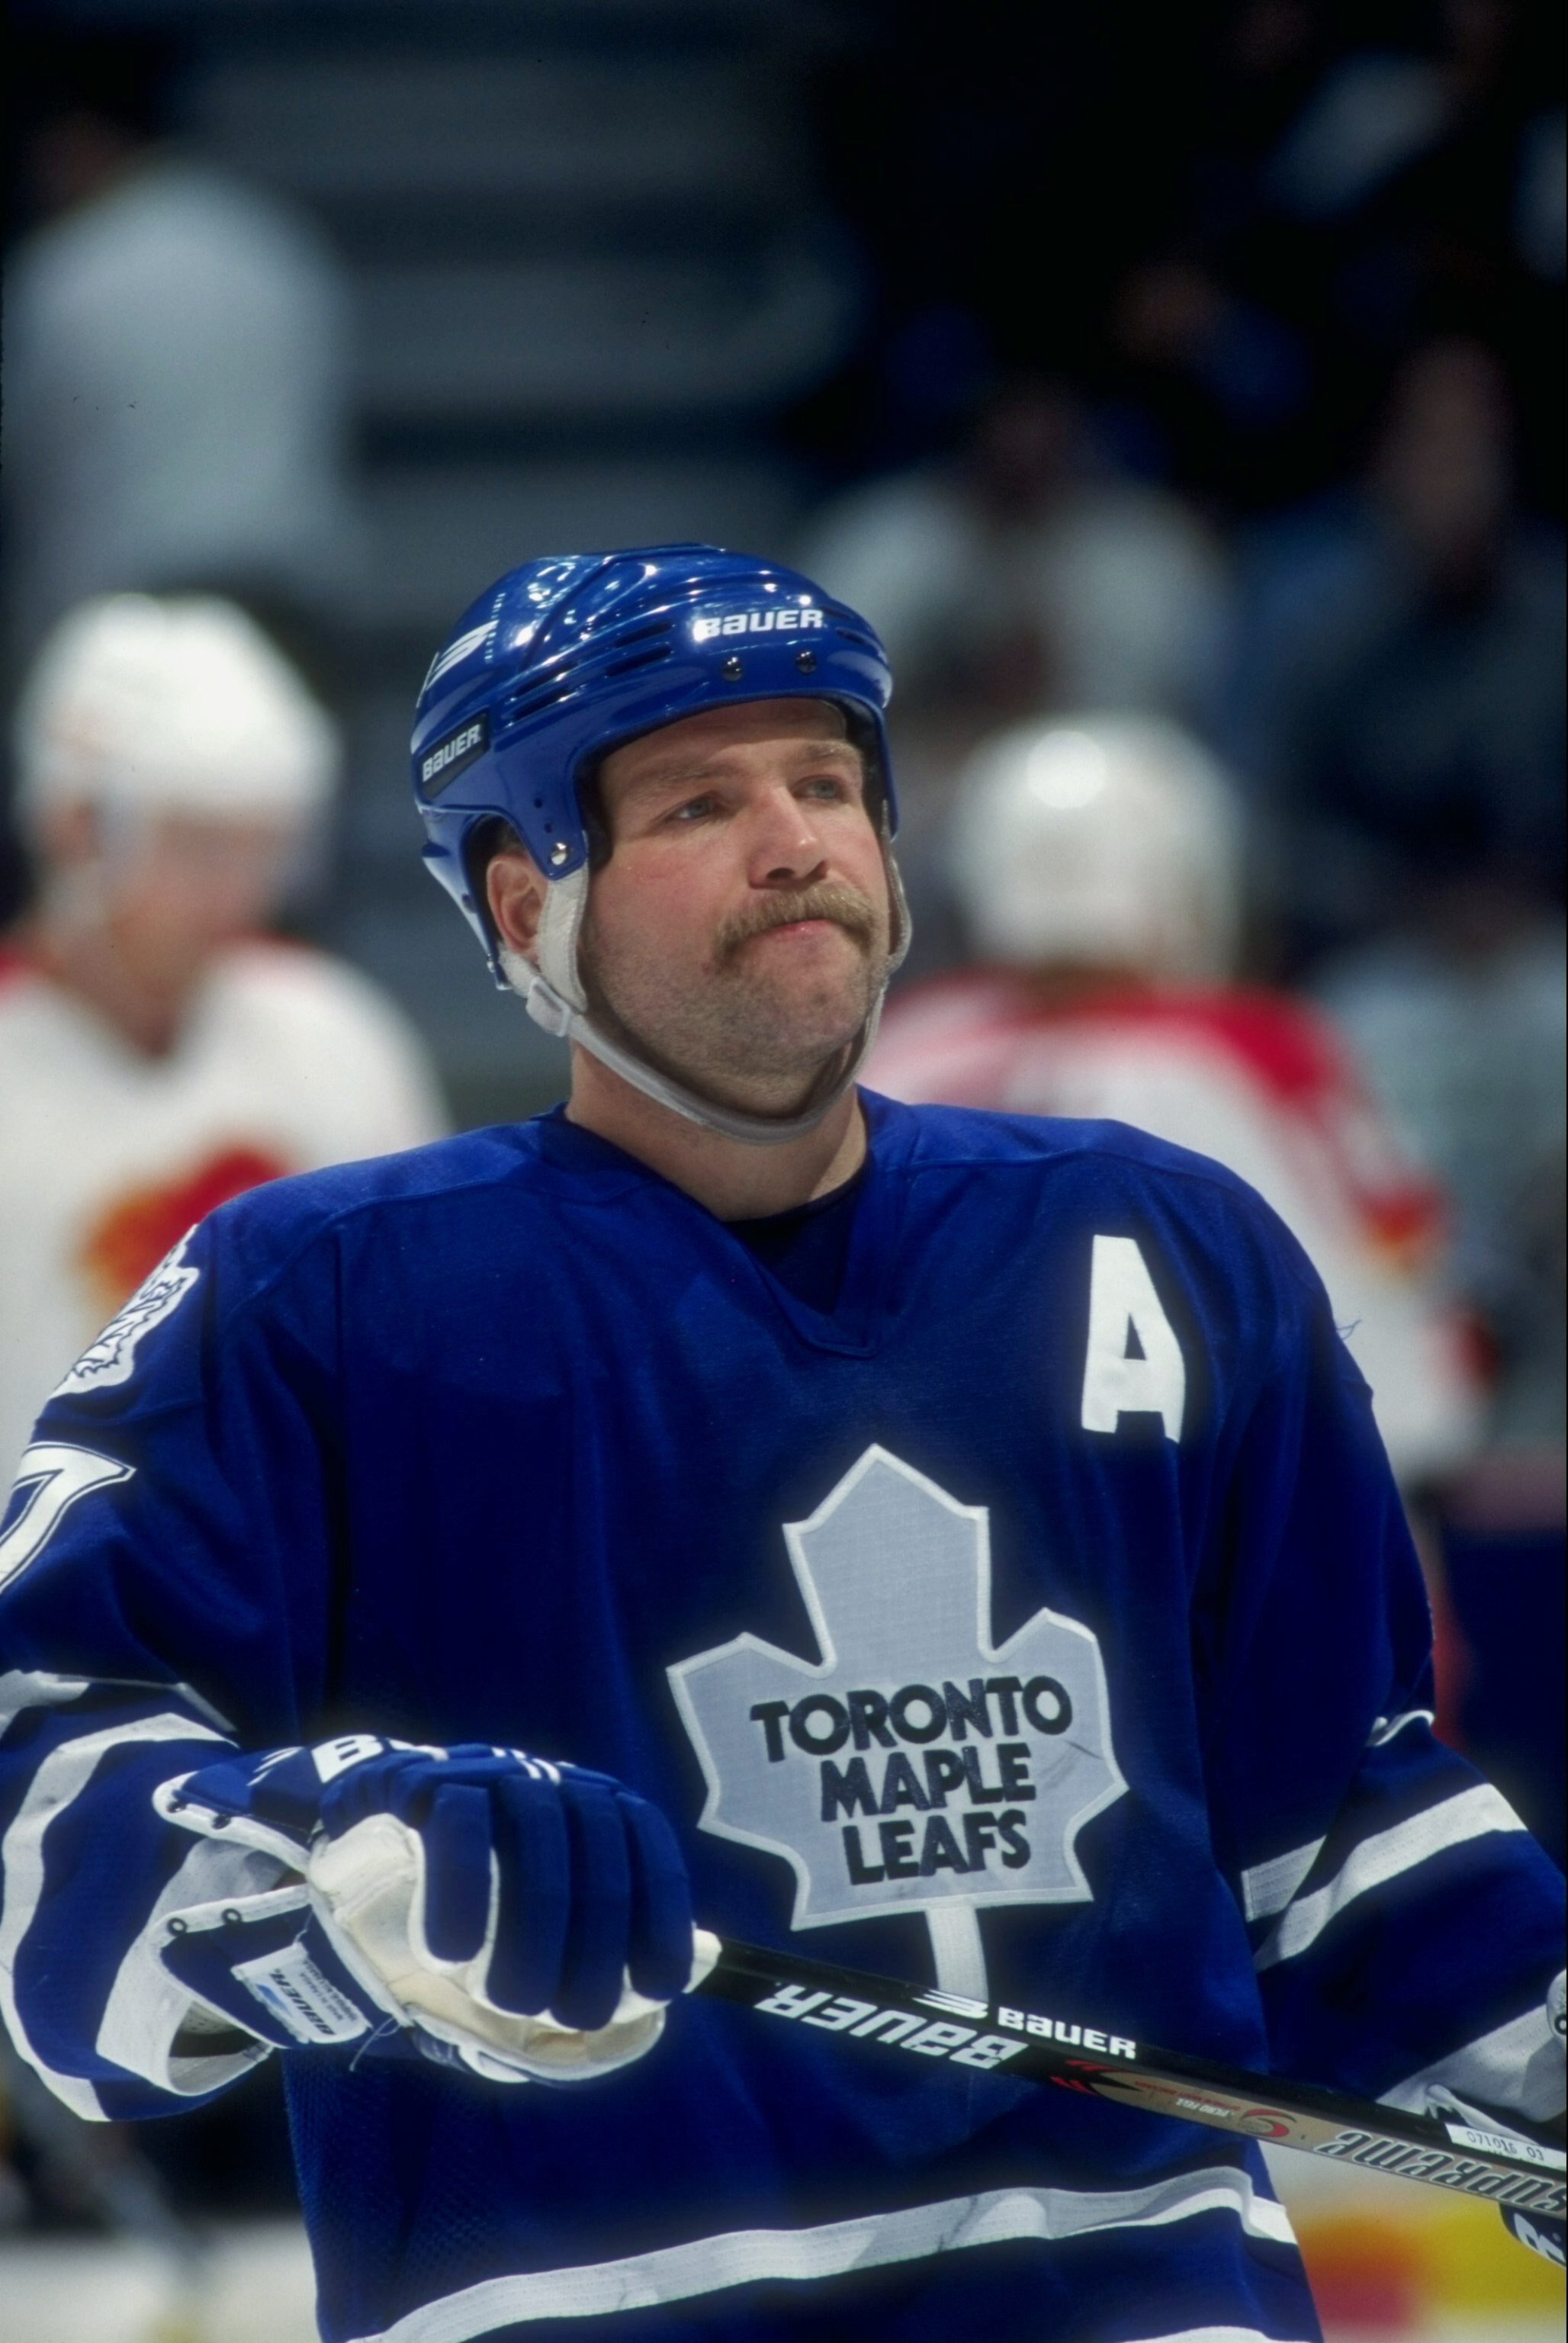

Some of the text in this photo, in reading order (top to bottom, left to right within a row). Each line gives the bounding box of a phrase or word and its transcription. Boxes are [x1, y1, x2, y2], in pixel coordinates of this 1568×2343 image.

[692, 609, 824, 642] BAUER
[423, 724, 481, 783] BAUER
[1081, 1233, 1186, 1445] A
[750, 1675, 1073, 1763] TORONTO
[820, 1742, 1036, 1823] MAPLE
[841, 1809, 1031, 1885] LEAFS
[753, 1984, 1029, 2069] BAUER
[998, 2006, 1136, 2059] BAUER
